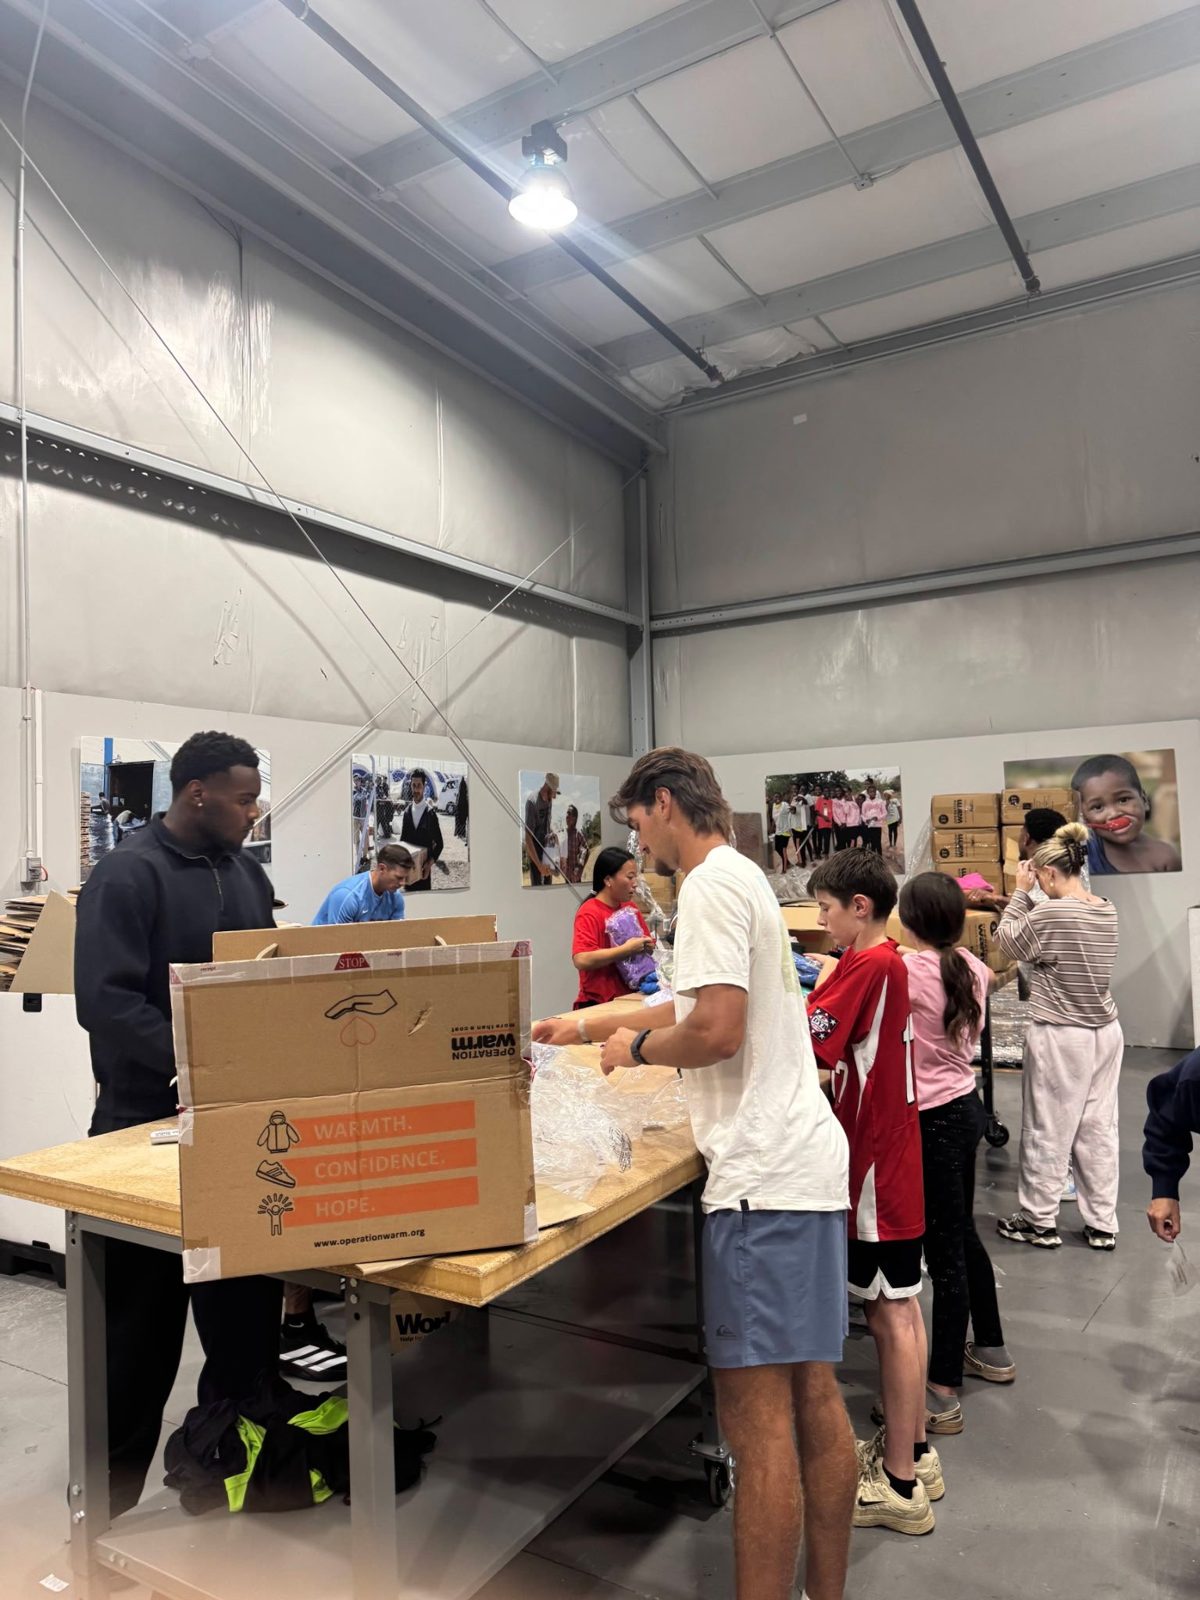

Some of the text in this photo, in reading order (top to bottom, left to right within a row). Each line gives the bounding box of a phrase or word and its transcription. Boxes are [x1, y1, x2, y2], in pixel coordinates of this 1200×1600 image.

[339, 957, 365, 969] STOP
[451, 1034, 515, 1050] warm
[452, 1048, 515, 1060] OPERATION
[314, 1115, 412, 1140] WARMTH.
[314, 1150, 445, 1178] CONFIDENCE.
[316, 1197, 376, 1217] HOPE.
[314, 1228, 425, 1248] www.operationwarm.org
